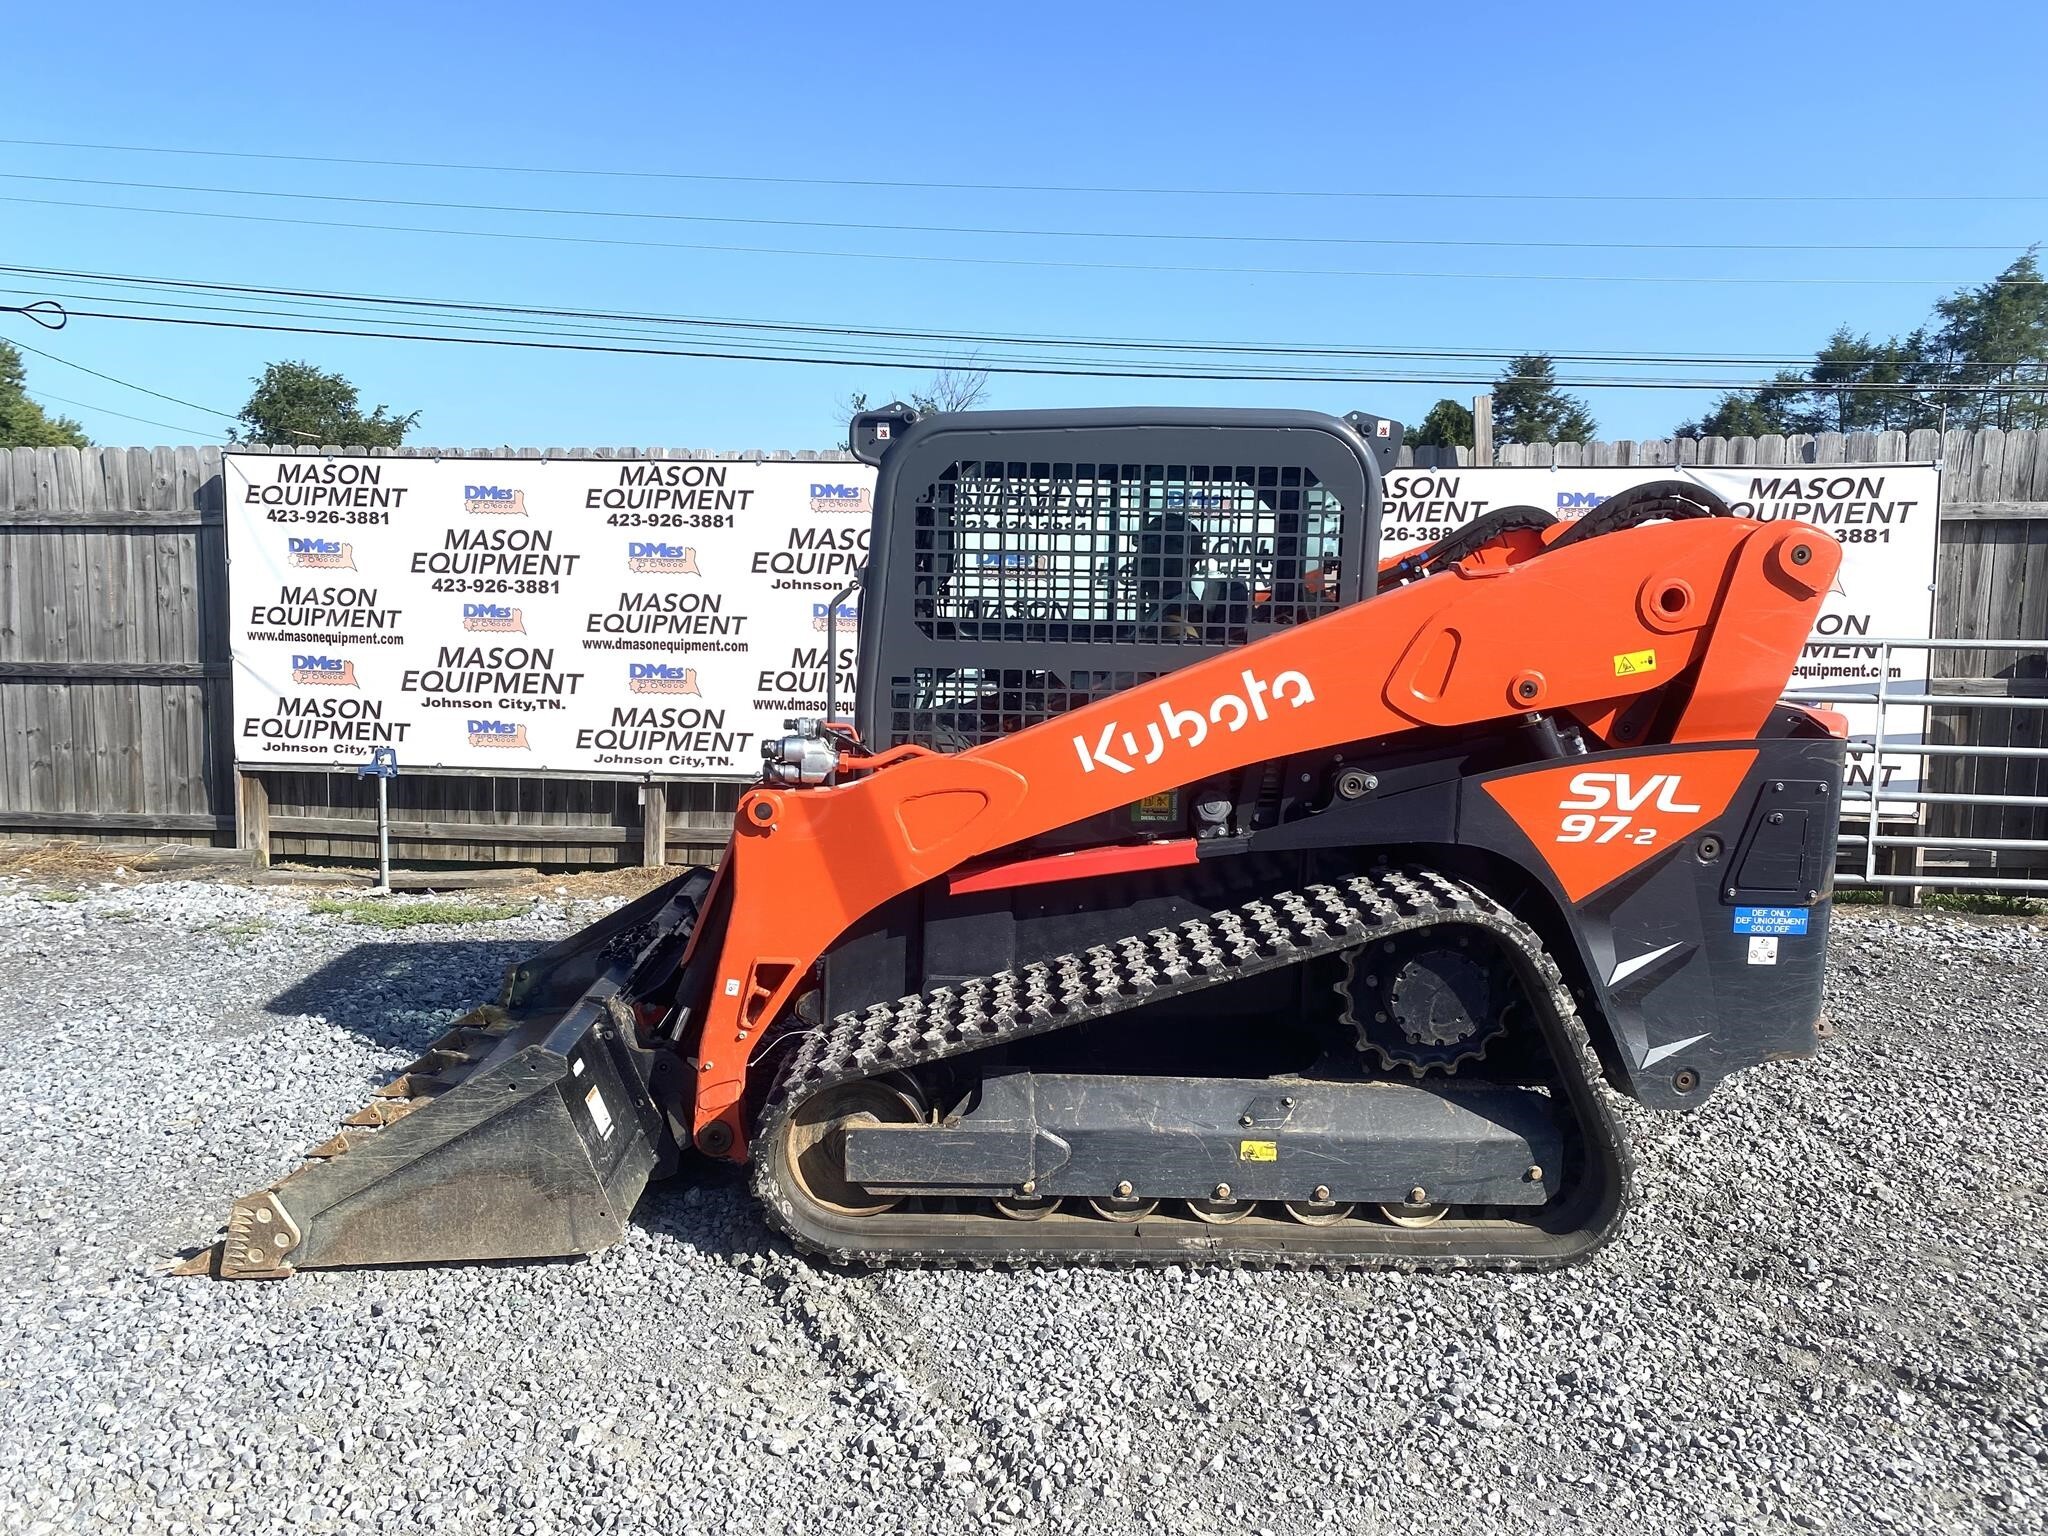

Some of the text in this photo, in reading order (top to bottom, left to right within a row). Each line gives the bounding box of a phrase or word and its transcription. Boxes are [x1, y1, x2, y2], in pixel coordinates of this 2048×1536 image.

[277, 464, 381, 485] MASON
[619, 466, 726, 486] MASON
[245, 485, 407, 508] EQUIPMENT
[585, 488, 754, 511] EQUIPMENT
[1748, 477, 1885, 500] MASON
[267, 509, 389, 525] 423-926-3881
[607, 514, 734, 528] 423-926-3881
[1729, 501, 1917, 524] QUIPMENT
[444, 529, 552, 550] MASON
[788, 527, 870, 550] MASO
[411, 552, 580, 576] EQUIPMENT
[751, 552, 869, 574] EQUIPM
[432, 578, 559, 594] 423-926-3881
[771, 579, 843, 590] Johnson
[280, 586, 377, 607] MASON
[618, 593, 722, 613] MASON
[251, 606, 402, 628] EQUIPMENT
[586, 614, 747, 635] EQUIPMENT
[247, 630, 404, 646] www.dmasonequipment.com
[583, 638, 748, 653] www.dmasonequipment.com
[438, 647, 553, 670] MASON
[401, 670, 584, 694] EQUIPMENT
[277, 697, 382, 719] MASON
[421, 697, 566, 711] Johnson City,TN.
[611, 707, 725, 729] MASON
[1073, 668, 1315, 774] Kubota
[243, 718, 410, 742] EQUIPMENT
[576, 729, 753, 752] EQUIPMENT
[262, 742, 328, 753] Johnson
[594, 754, 734, 768] Johnson City,TN.
[1558, 773, 1701, 813] SVL
[1556, 815, 1657, 845] 97-2
[1754, 917, 1806, 925] UNIQUEMENT
